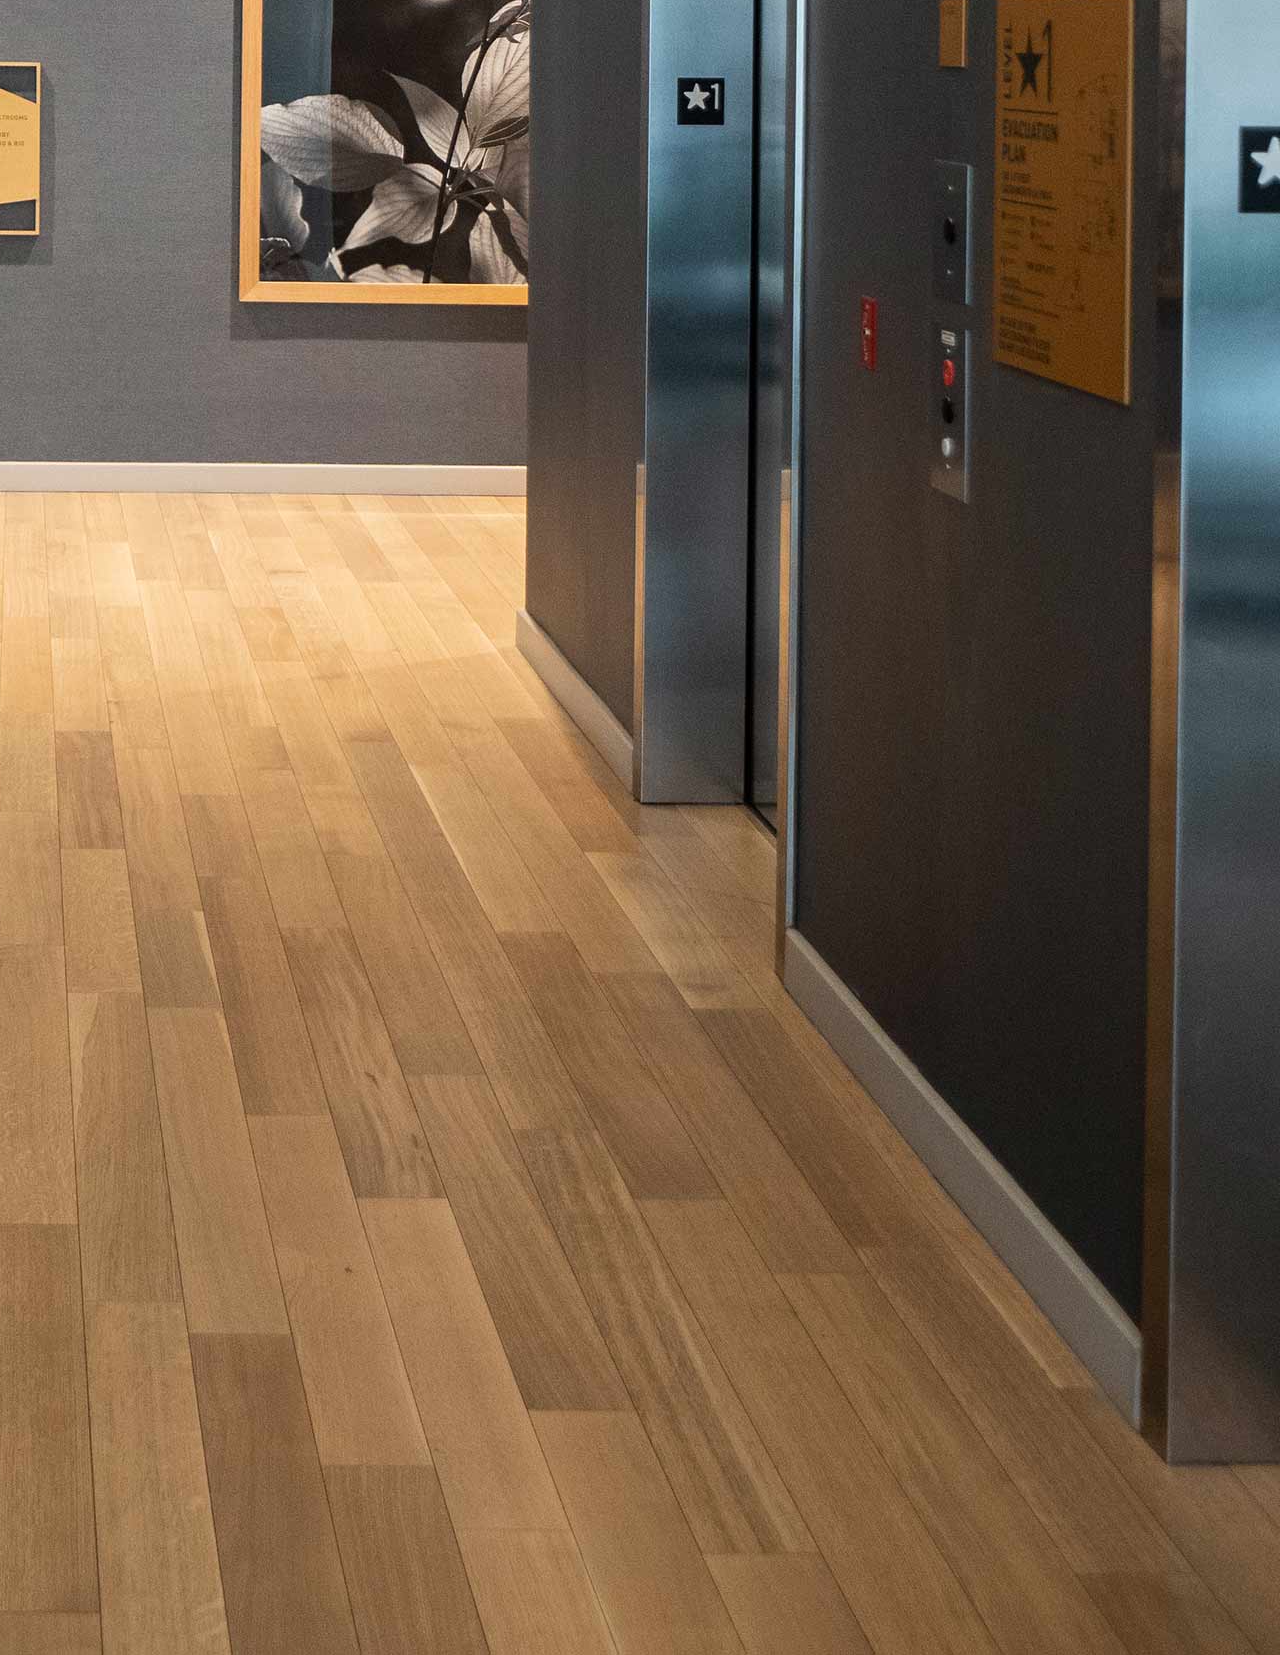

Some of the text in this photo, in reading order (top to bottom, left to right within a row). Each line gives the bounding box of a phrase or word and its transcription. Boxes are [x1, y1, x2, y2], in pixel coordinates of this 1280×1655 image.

[1003, 19, 1013, 100] LEVEL
[1041, 19, 1053, 104] 1
[710, 83, 719, 109] 1
[1002, 118, 1058, 142] EVACUATION
[1002, 143, 1026, 162] PLAN
